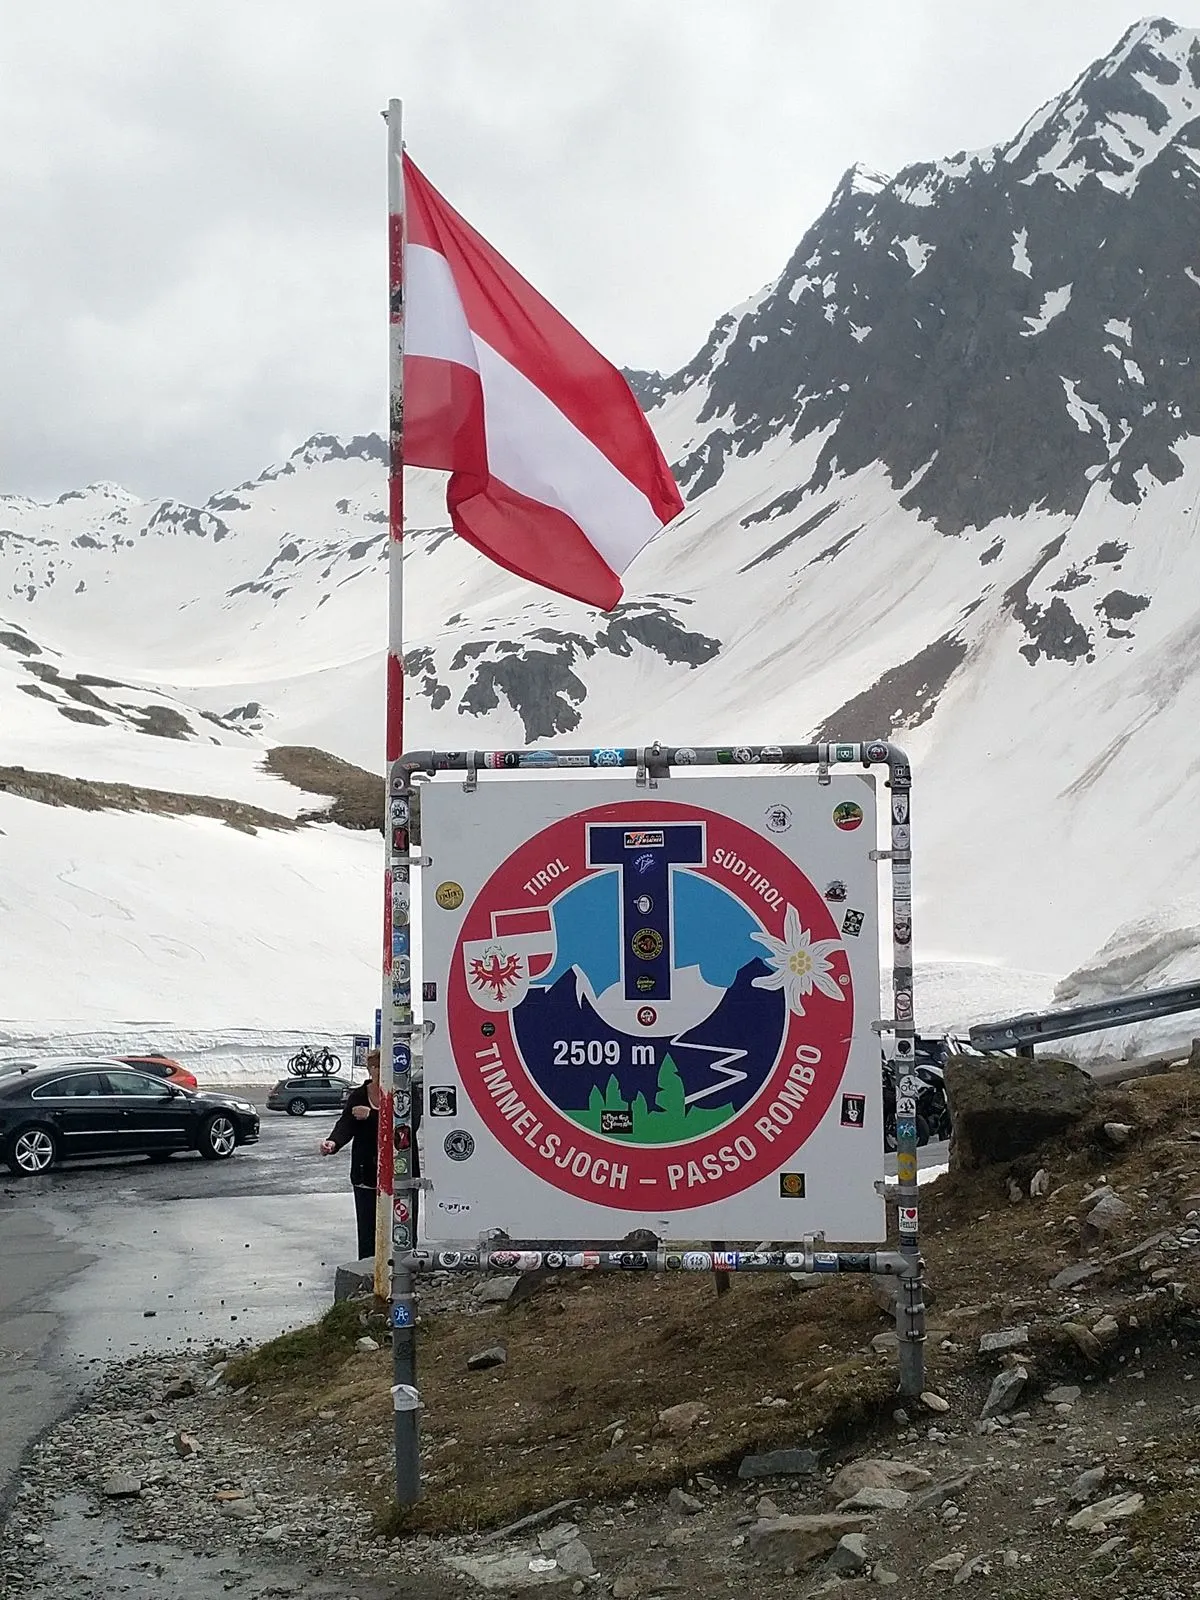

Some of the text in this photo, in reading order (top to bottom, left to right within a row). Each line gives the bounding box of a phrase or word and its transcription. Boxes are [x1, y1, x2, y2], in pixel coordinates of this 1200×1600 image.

[523, 857, 570, 897] TIROL
[711, 847, 785, 913] SÜDTIROL
[552, 1039, 656, 1066] 2509 m
[475, 1042, 629, 1190] TIMMELSJOCH
[666, 1134, 758, 1191] PASSO
[753, 1043, 823, 1143] ROMBO
